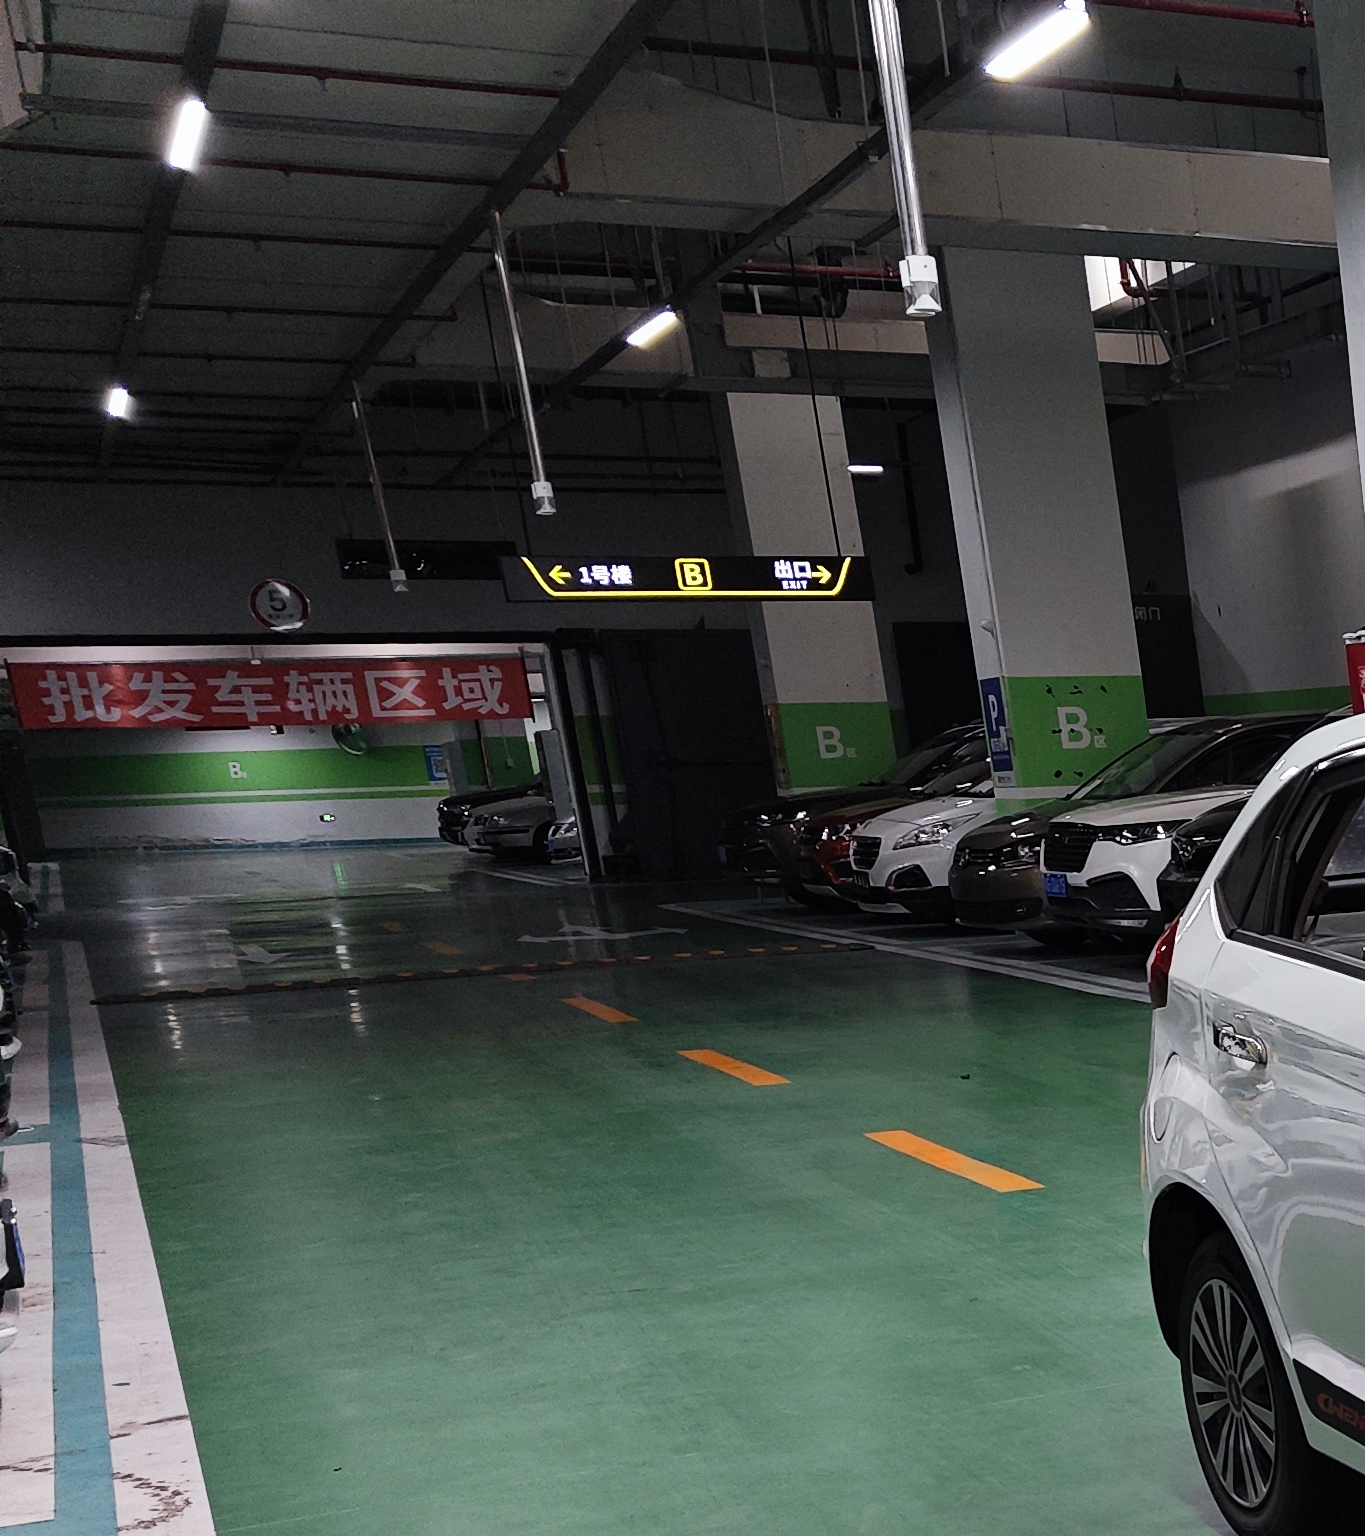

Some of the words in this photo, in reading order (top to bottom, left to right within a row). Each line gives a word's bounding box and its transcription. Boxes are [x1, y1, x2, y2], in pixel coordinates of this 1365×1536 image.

[578, 563, 633, 586] 1号楼
[683, 563, 704, 586] B
[773, 560, 813, 579] 出口
[781, 580, 808, 590] EXIT
[269, 590, 288, 612] 5
[38, 664, 510, 724] 批发车辆区域
